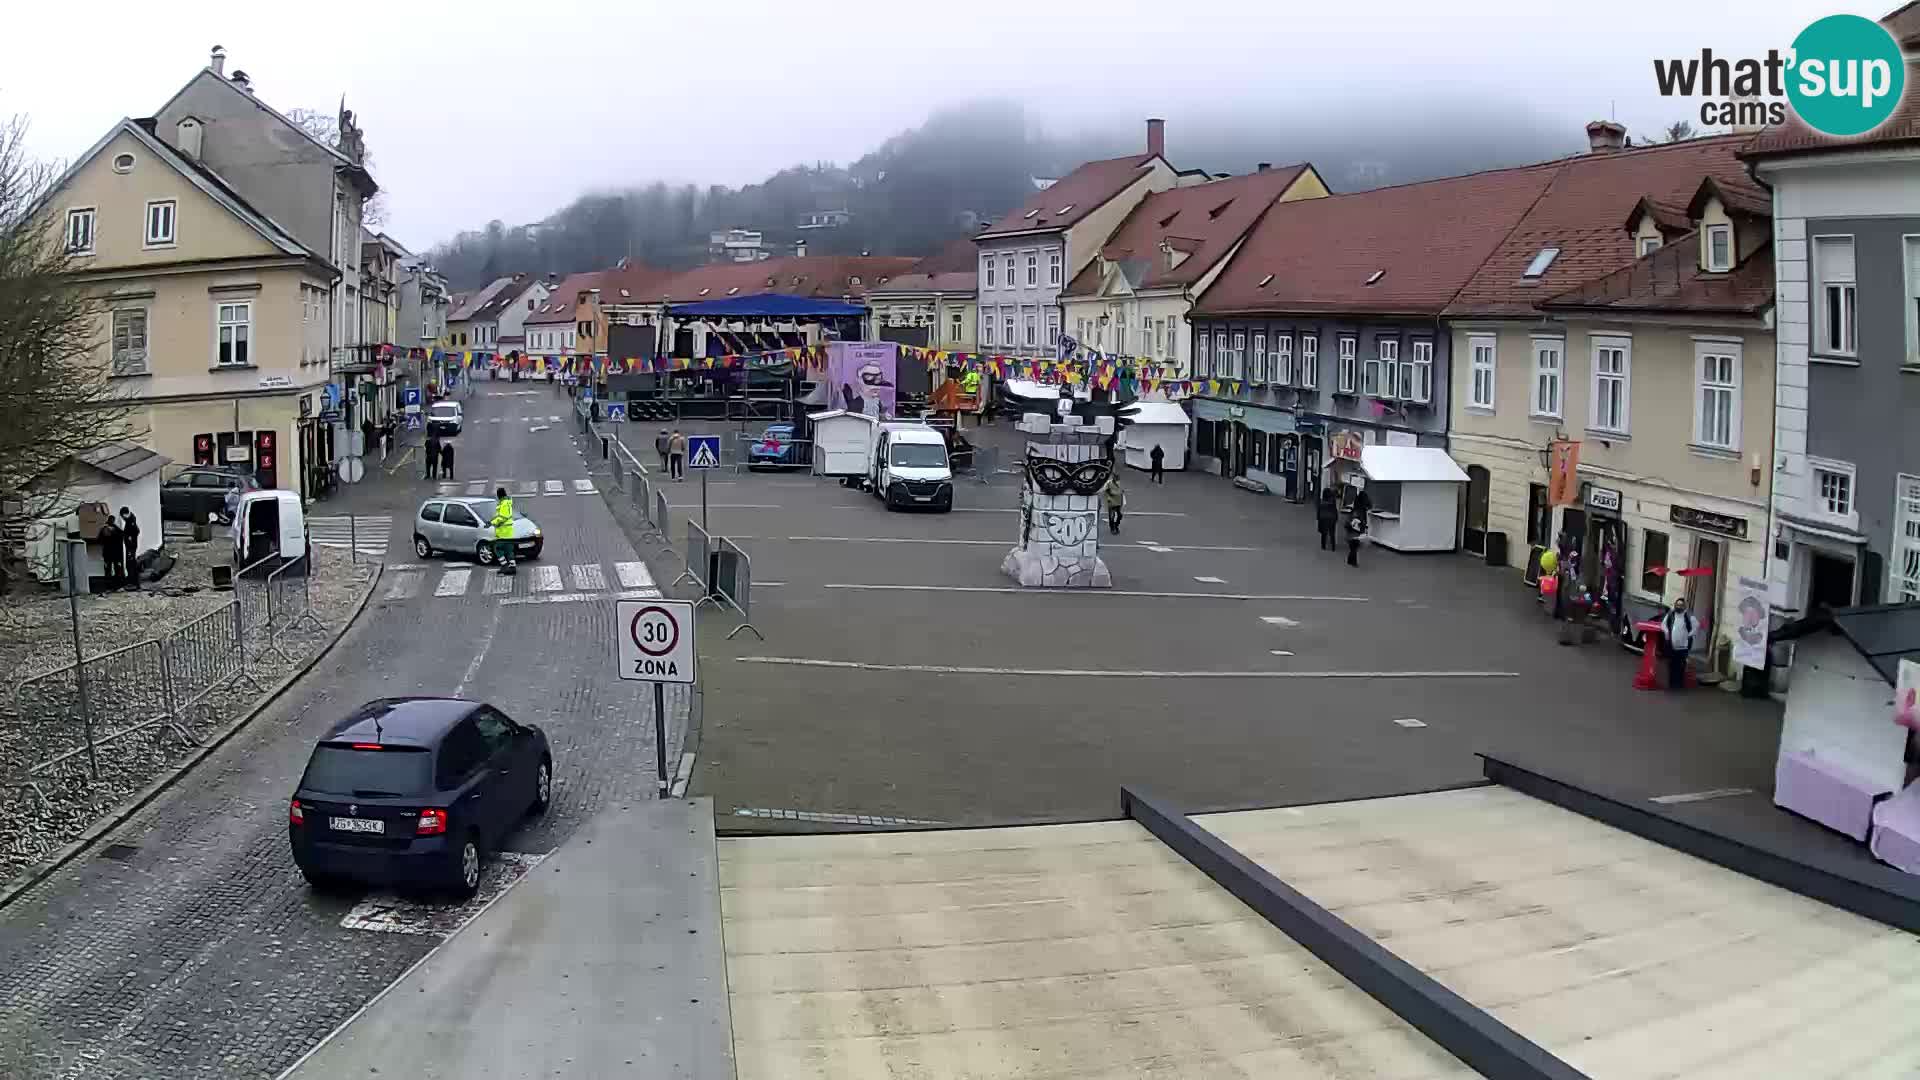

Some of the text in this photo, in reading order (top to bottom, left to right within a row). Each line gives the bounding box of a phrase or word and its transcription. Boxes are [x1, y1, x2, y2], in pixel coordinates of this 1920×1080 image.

[408, 391, 417, 403] P
[1048, 516, 1087, 545] 200
[643, 622, 668, 642] 30
[634, 659, 678, 676] ZONA
